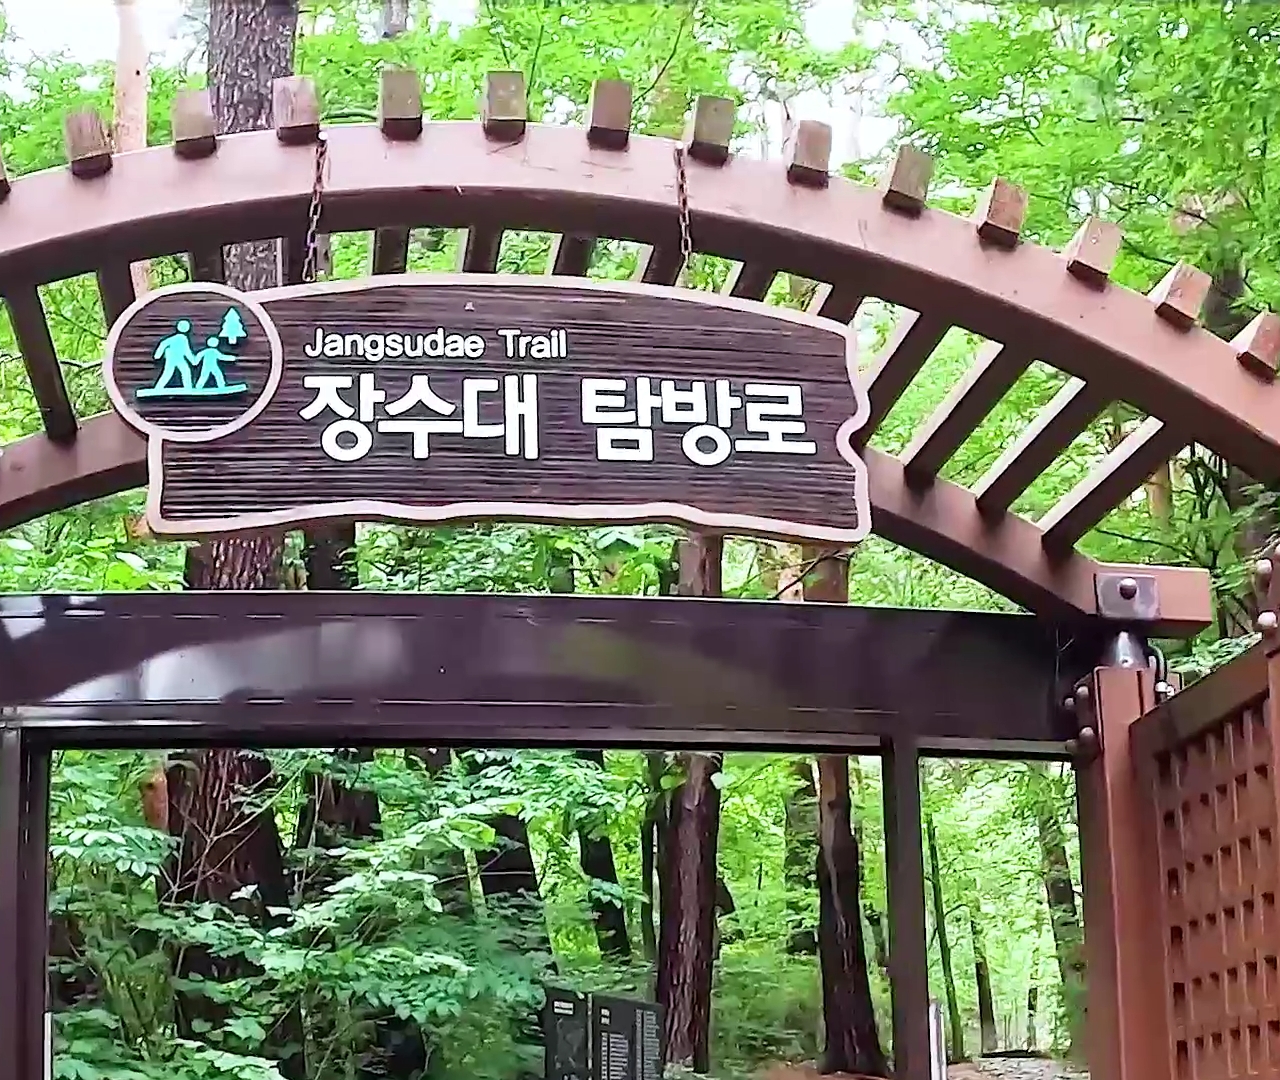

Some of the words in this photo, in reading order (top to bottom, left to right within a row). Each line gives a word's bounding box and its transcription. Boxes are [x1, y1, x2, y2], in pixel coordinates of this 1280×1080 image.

[303, 327, 486, 362] Jangsudae
[496, 328, 567, 358] Trail
[298, 372, 540, 462] 장수대
[581, 376, 818, 467] 탐방로
